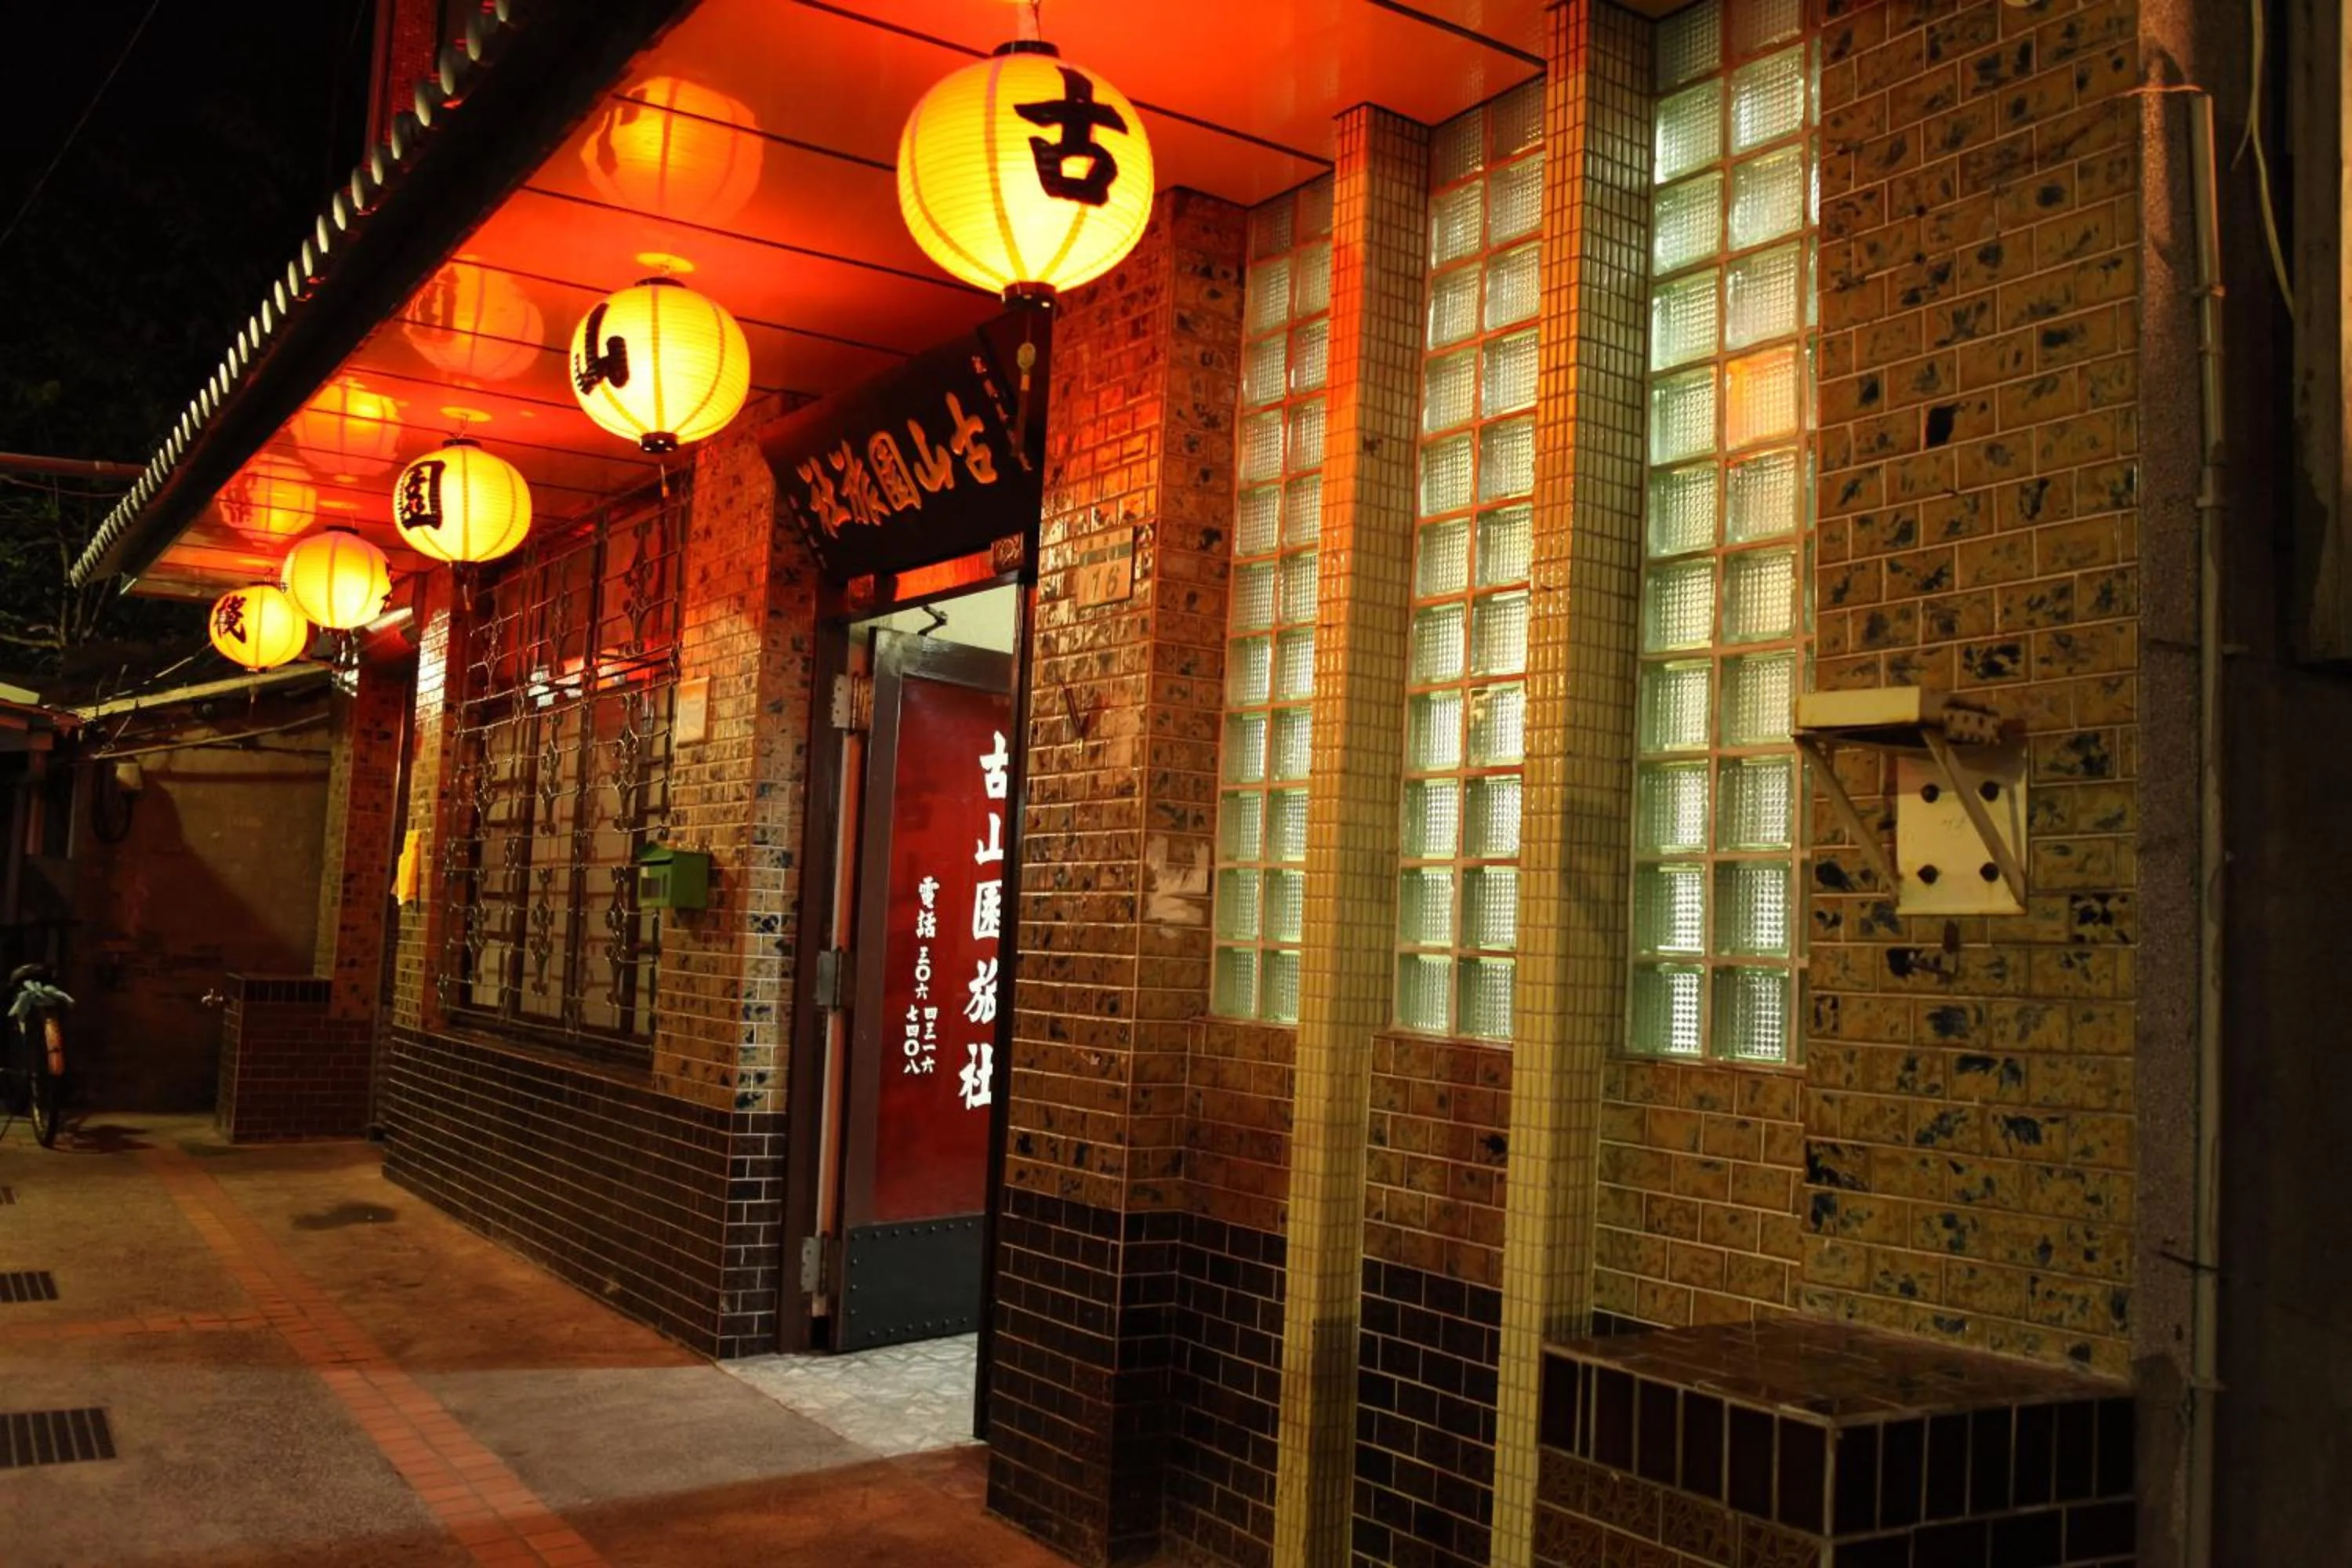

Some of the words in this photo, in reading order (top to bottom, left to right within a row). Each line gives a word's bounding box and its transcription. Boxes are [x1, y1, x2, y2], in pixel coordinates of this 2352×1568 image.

[1013, 64, 1129, 209] 古
[575, 302, 630, 396] 山
[397, 459, 447, 531] 園
